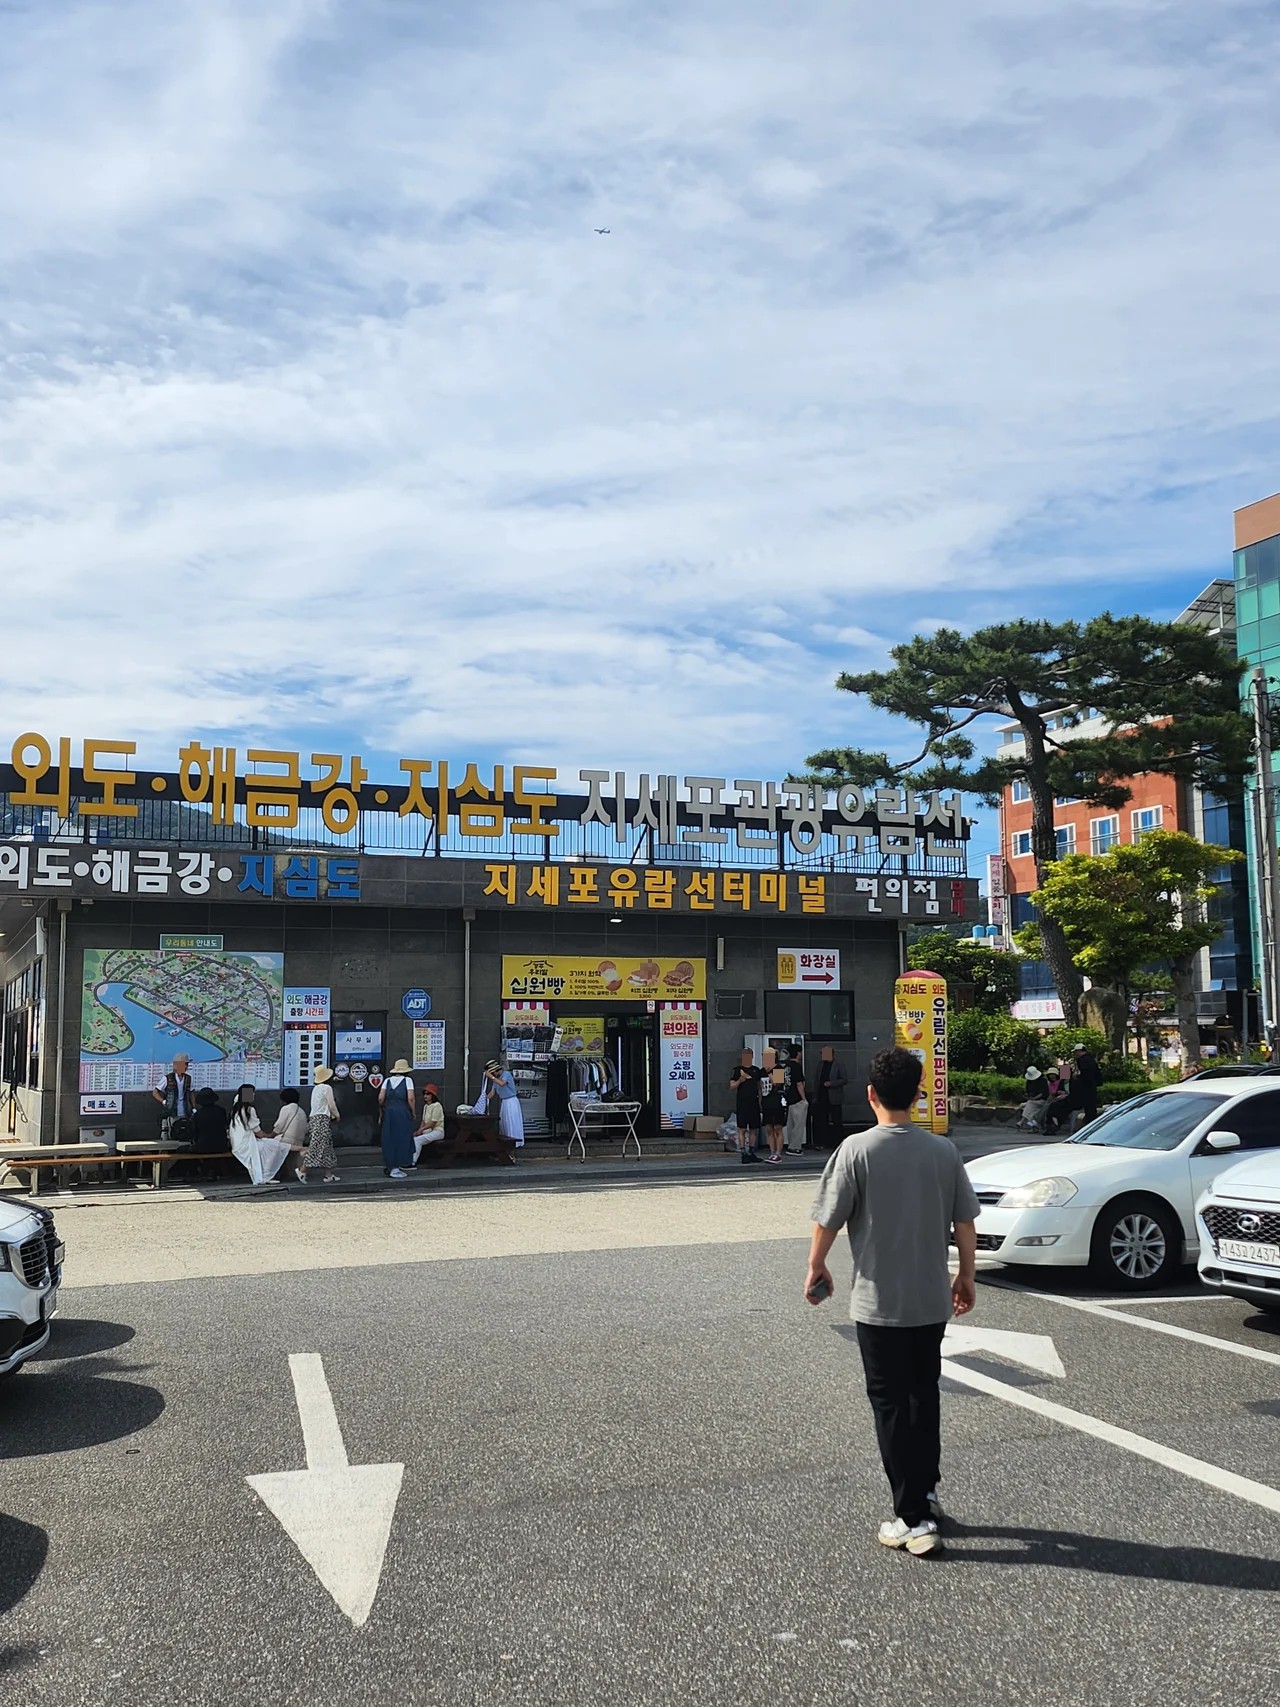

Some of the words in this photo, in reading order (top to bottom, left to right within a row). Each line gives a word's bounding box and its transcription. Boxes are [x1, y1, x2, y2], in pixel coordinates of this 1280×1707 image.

[579, 769, 964, 857] 지세포관광유람선
[483, 865, 826, 913] 지세포유람선터미널
[855, 877, 940, 914] 편의점
[196, 939, 217, 947] 안내도
[800, 954, 836, 968] 화장실
[510, 976, 566, 996] 십원빵
[286, 994, 302, 1005] 외도
[303, 994, 328, 1006] 해금강
[407, 998, 427, 1009] ADT
[290, 1007, 303, 1017] 출항
[304, 1007, 325, 1016] 시간표
[663, 1022, 699, 1036] 편의점
[346, 1036, 372, 1044] 사무실
[673, 1060, 691, 1071] 쇼핑
[668, 1071, 696, 1081] 오세요
[87, 1098, 118, 1110] 매표소
[1249, 1245, 1276, 1262] 2437
